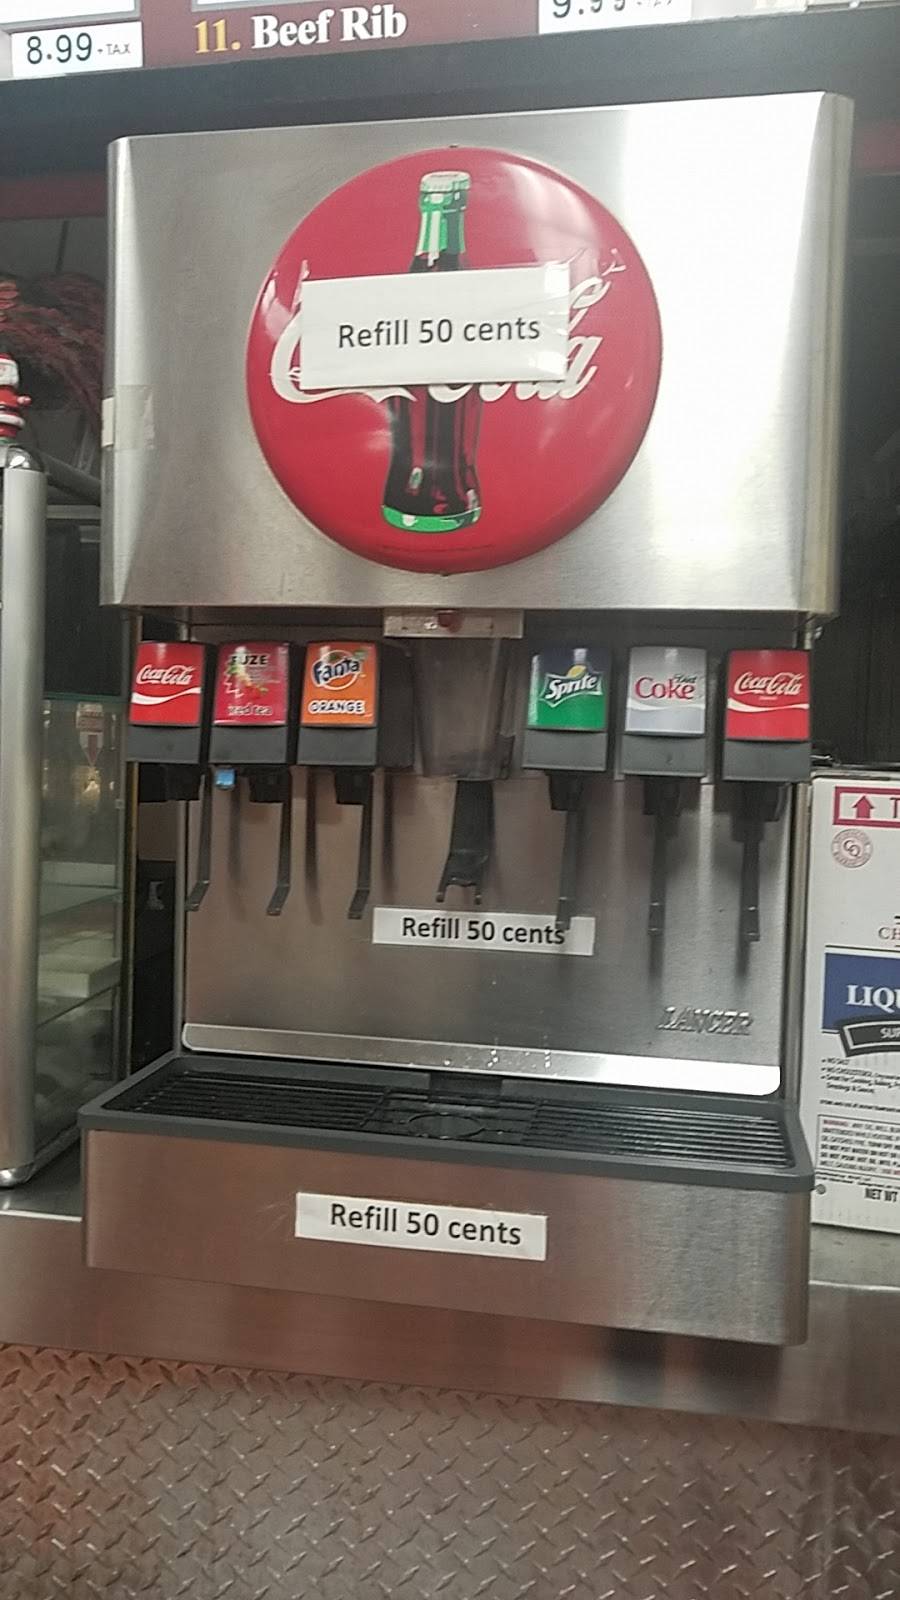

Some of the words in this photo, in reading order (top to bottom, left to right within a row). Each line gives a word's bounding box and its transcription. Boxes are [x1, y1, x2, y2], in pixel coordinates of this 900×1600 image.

[194, 19, 241, 53] 11.
[251, 9, 335, 49] Beef
[340, 4, 408, 41] Rib
[27, 32, 92, 64] 8.99
[338, 319, 409, 348] Refill
[419, 318, 452, 344] 50
[463, 316, 541, 342] cents
[313, 660, 361, 686] Fanta
[545, 674, 599, 700] Sprite
[635, 676, 695, 700] Coke
[309, 699, 366, 714] ORANGE
[402, 916, 460, 940] Refill
[467, 920, 495, 941] 50
[502, 926, 565, 946] cents
[330, 1203, 397, 1232] Refill
[406, 1211, 439, 1236] 50
[448, 1221, 521, 1246] cents
